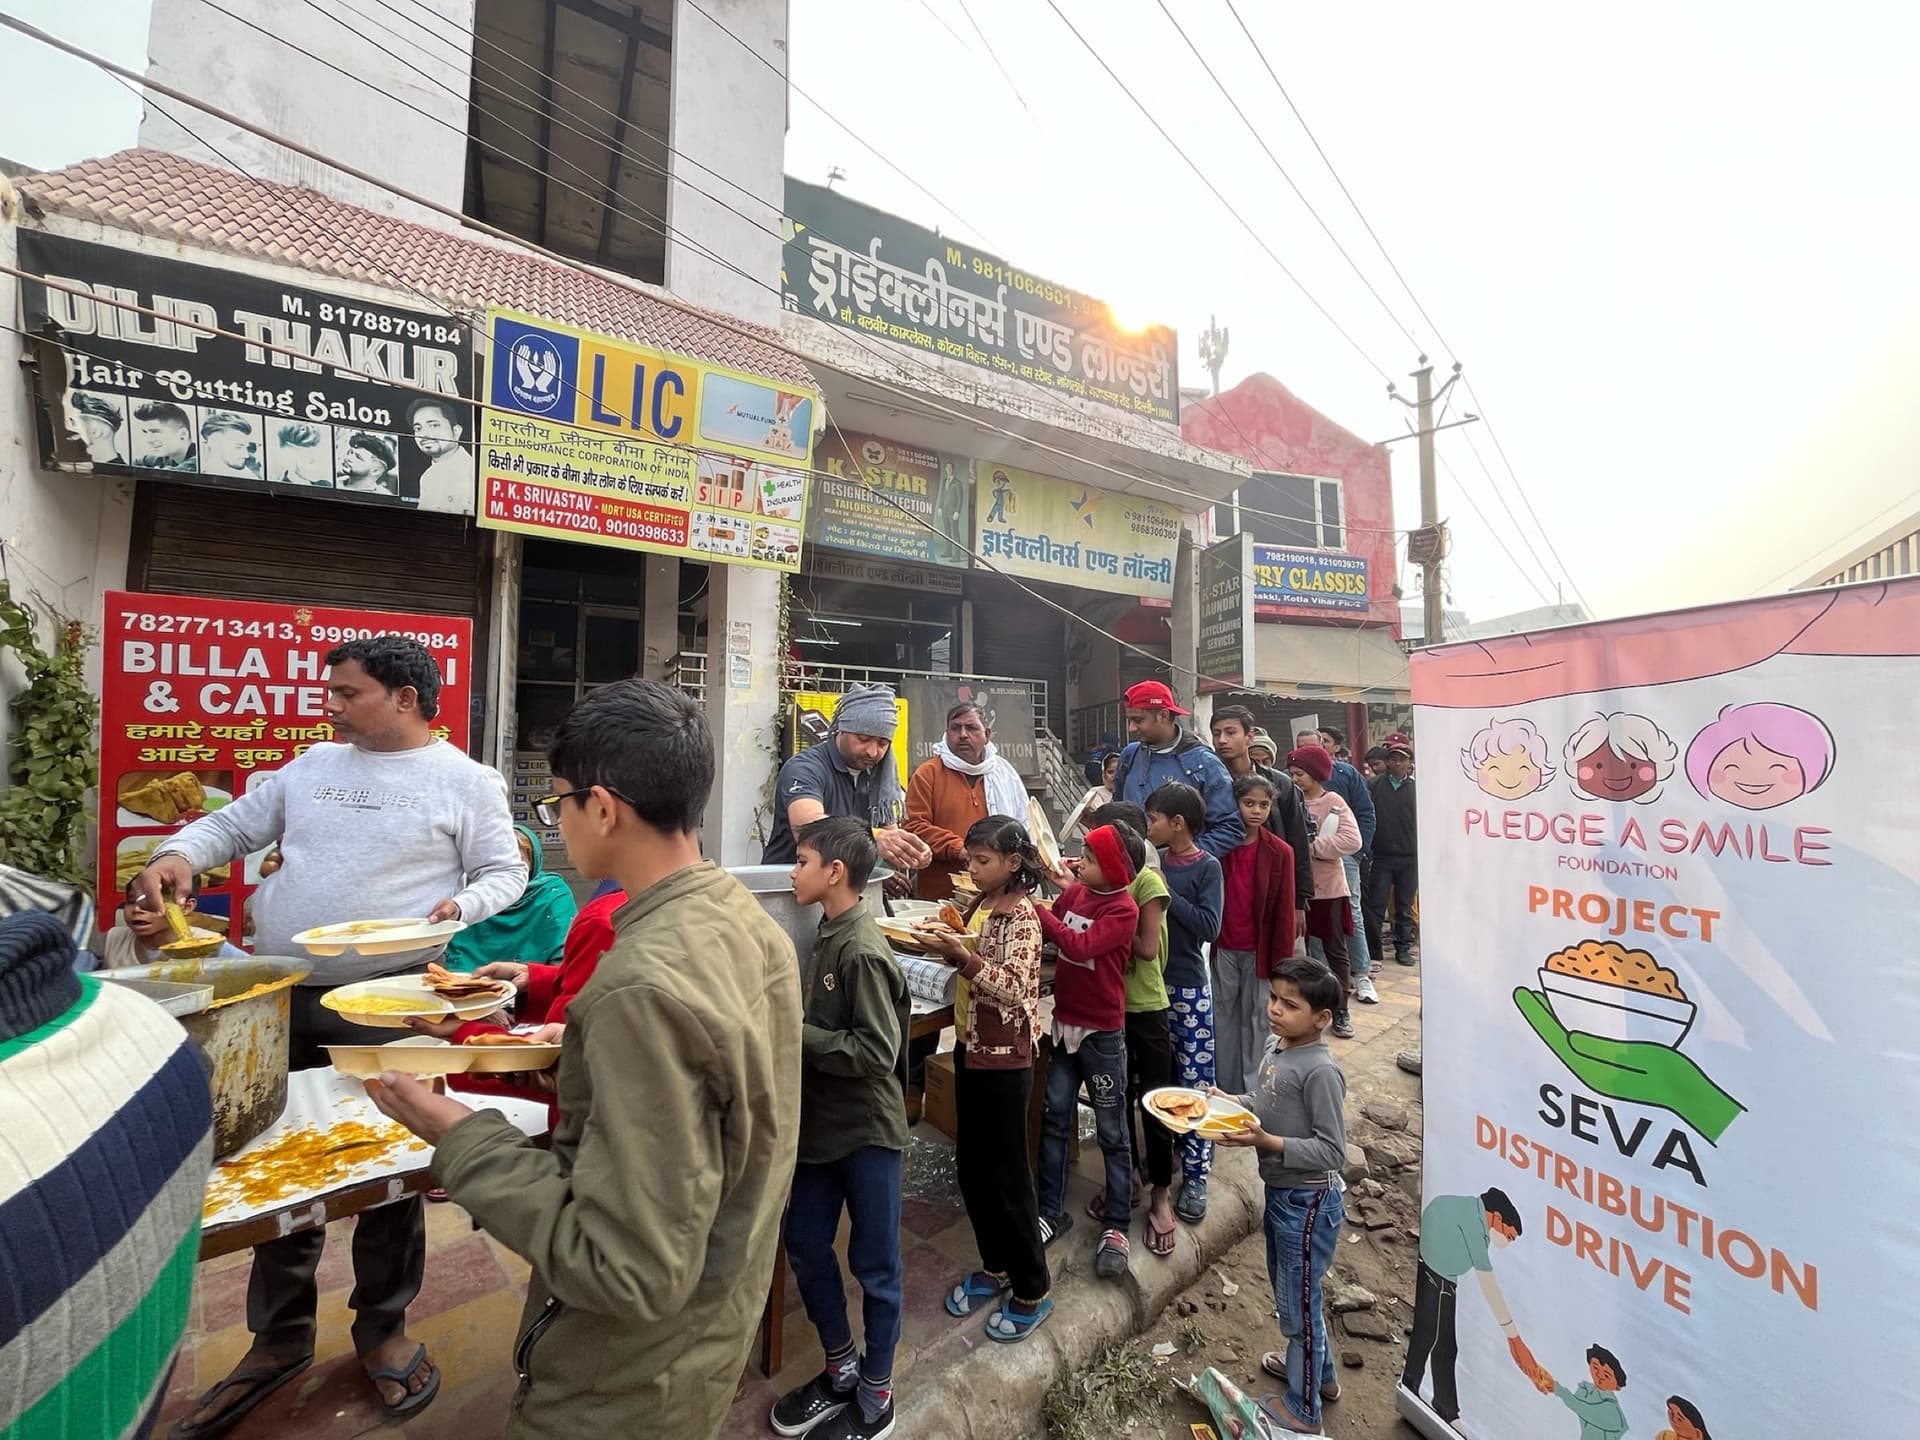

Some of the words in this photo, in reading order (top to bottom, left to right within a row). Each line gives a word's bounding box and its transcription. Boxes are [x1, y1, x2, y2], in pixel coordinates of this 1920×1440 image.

[946, 246, 966, 270] M.
[44, 274, 217, 354] DILIP
[233, 310, 459, 397] THAKUR
[282, 295, 311, 318] M.
[319, 303, 461, 345] 8178879184
[1014, 308, 1074, 372] एण्ड
[66, 353, 142, 389] Hair
[156, 369, 294, 416] Cutting
[305, 392, 392, 427] Salon
[591, 354, 685, 439] LIC
[489, 433, 510, 445] LIFE
[514, 438, 575, 459] INSURANCE
[578, 451, 648, 472] CORPORATION
[650, 465, 661, 474] OF
[664, 468, 690, 480] INDIA
[490, 418, 551, 440] भारतीय
[560, 432, 605, 451] जीवन
[613, 441, 644, 459] बीमा
[653, 448, 690, 468] निगम
[488, 450, 511, 470] किसी
[513, 455, 523, 473] भी
[526, 461, 549, 477] प्रकार
[550, 462, 561, 479] के
[582, 467, 597, 487] और
[599, 471, 616, 490] लोन
[617, 474, 627, 491] के
[628, 474, 643, 494] लिए
[644, 481, 670, 498] सम्पर्क
[776, 480, 802, 489] HEALTH
[823, 481, 874, 502] DESIGNER
[864, 466, 927, 495] STAR
[492, 481, 503, 498] P.
[508, 484, 520, 500] K.
[524, 486, 593, 512] SRIVASTAV
[601, 503, 623, 517] MDRT
[626, 508, 642, 520] USA
[643, 510, 684, 527] CERTIFIED
[766, 494, 802, 507] INSURANCE
[835, 499, 872, 513] TAILORS
[490, 501, 508, 517] M.
[513, 503, 601, 532] 9811477020,
[606, 519, 685, 544] 9010398633
[982, 528, 1080, 568] ड्राईक्लीनर्स
[1085, 548, 1118, 575] एण्ड
[1289, 567, 1366, 595] CLASSES
[1311, 596, 1336, 606] Vihar
[121, 611, 302, 643] 7827713413,
[1202, 593, 1240, 618] LAUNDRY
[123, 640, 271, 679] BILLA
[143, 679, 181, 713] &
[125, 721, 205, 740] हमारे
[210, 718, 268, 741] यहाँ
[273, 723, 335, 741] शादी
[233, 748, 286, 768] बुक
[1464, 808, 1606, 849] PLEDGE
[1619, 816, 1648, 853] A
[1659, 817, 1834, 867] SMILE
[1557, 855, 1678, 882] FOUNDATION
[1528, 885, 1721, 943] PROJECT
[1538, 1082, 1708, 1188] SEVA
[1475, 1114, 1819, 1312] DISTRIBUTION
[1545, 1205, 1692, 1316] DRIVE
